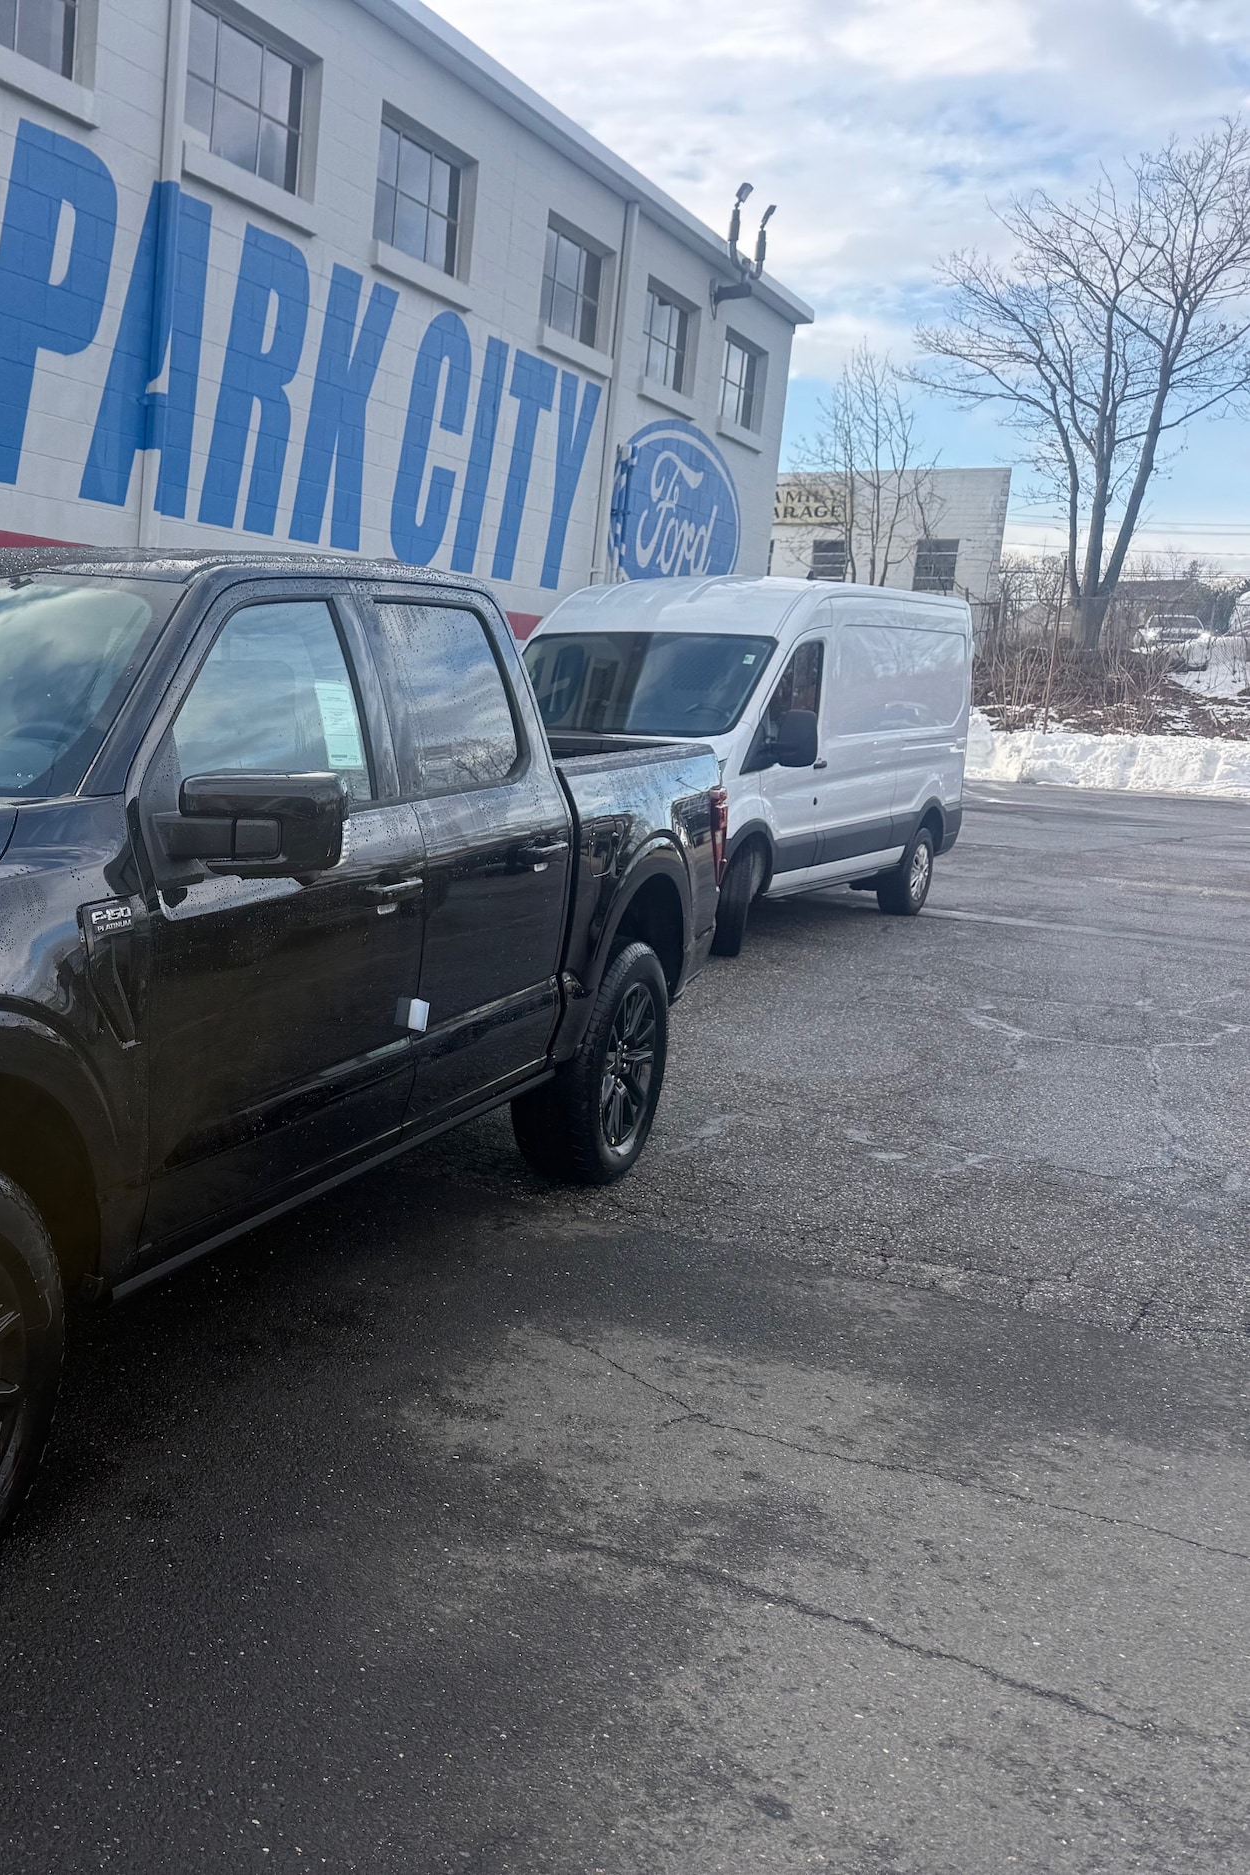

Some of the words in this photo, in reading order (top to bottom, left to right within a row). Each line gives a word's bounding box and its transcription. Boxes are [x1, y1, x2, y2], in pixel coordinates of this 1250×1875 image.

[389, 311, 602, 590] CITY
[635, 450, 719, 577] Ford
[91, 906, 132, 924] F-150
[97, 919, 132, 932] PLATINUM
